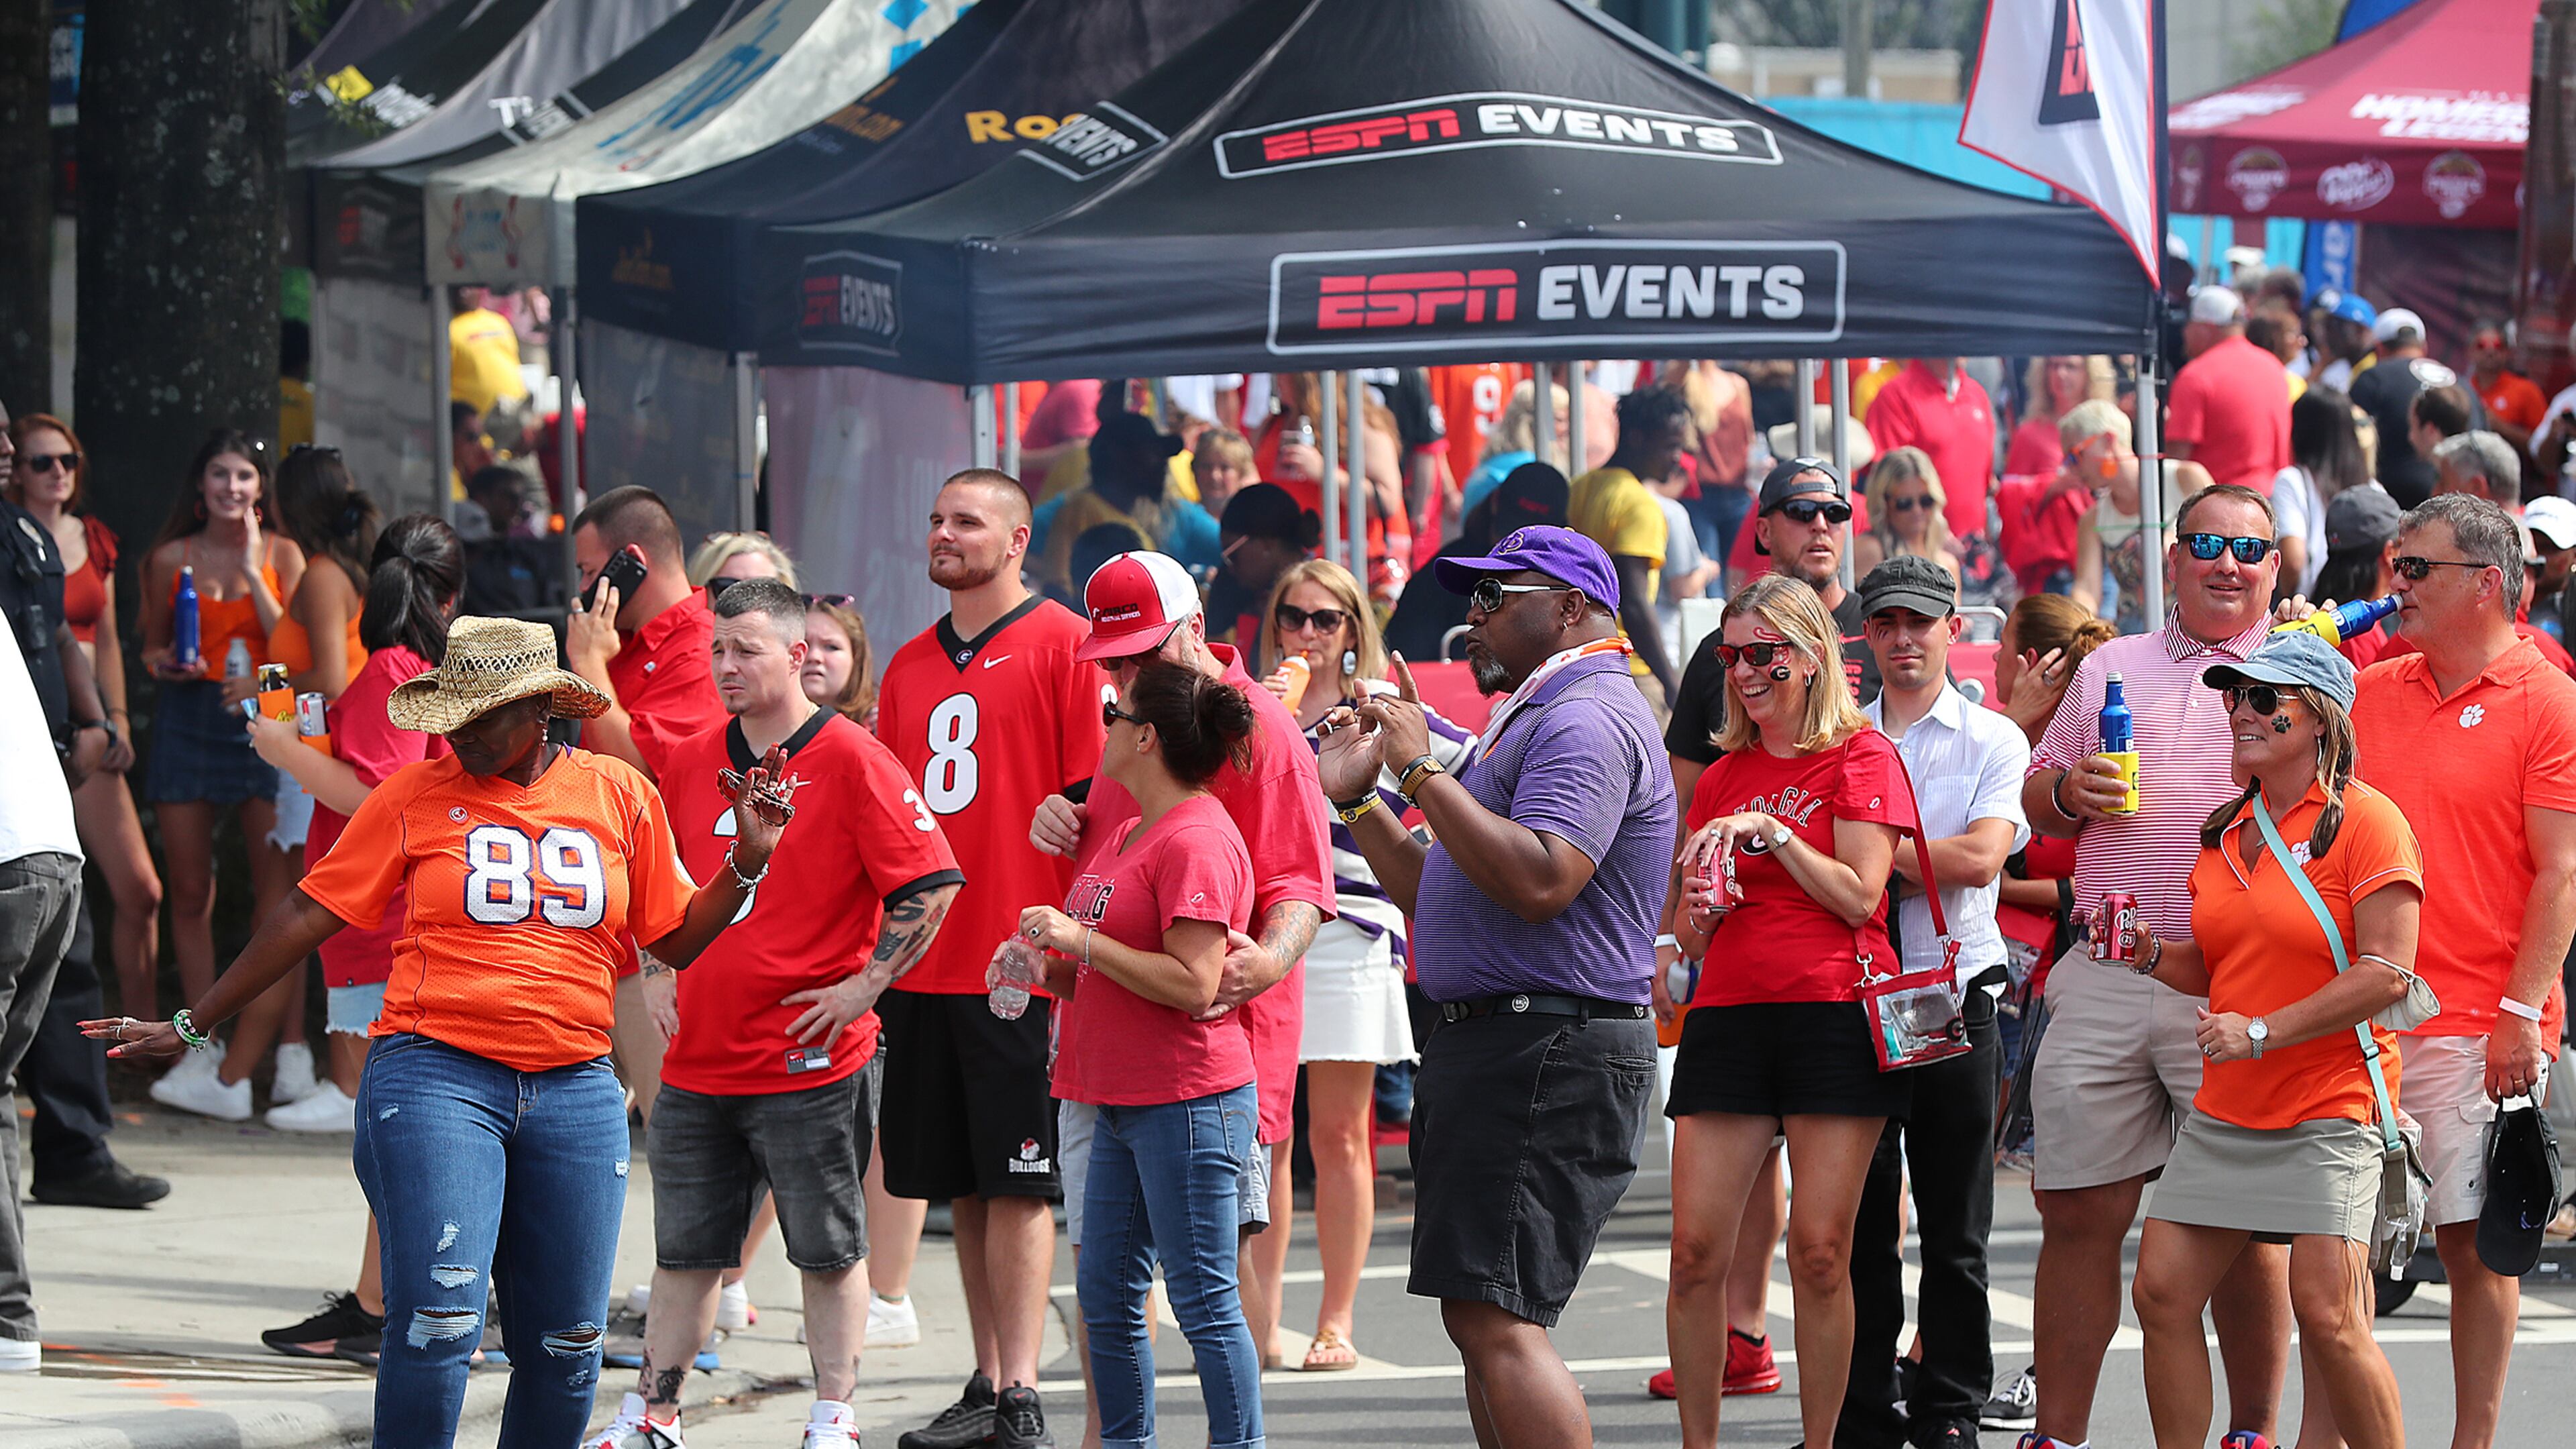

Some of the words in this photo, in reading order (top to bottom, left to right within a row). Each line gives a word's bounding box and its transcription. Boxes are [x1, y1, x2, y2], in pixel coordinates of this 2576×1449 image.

[1040, 113, 1138, 166] VENTS
[1263, 109, 1460, 162] ESPN
[1478, 104, 1739, 153] EVENTS
[802, 275, 840, 326] ESPN
[841, 274, 895, 335] EVENTS
[1316, 269, 1517, 329] ESPN
[1536, 264, 1805, 320] EVENTS
[1104, 602, 1138, 616] AIRCO
[923, 692, 979, 815] 8
[902, 788, 936, 833] 3
[464, 823, 606, 930] 89
[1008, 1157, 1051, 1173] BULLDOGS
